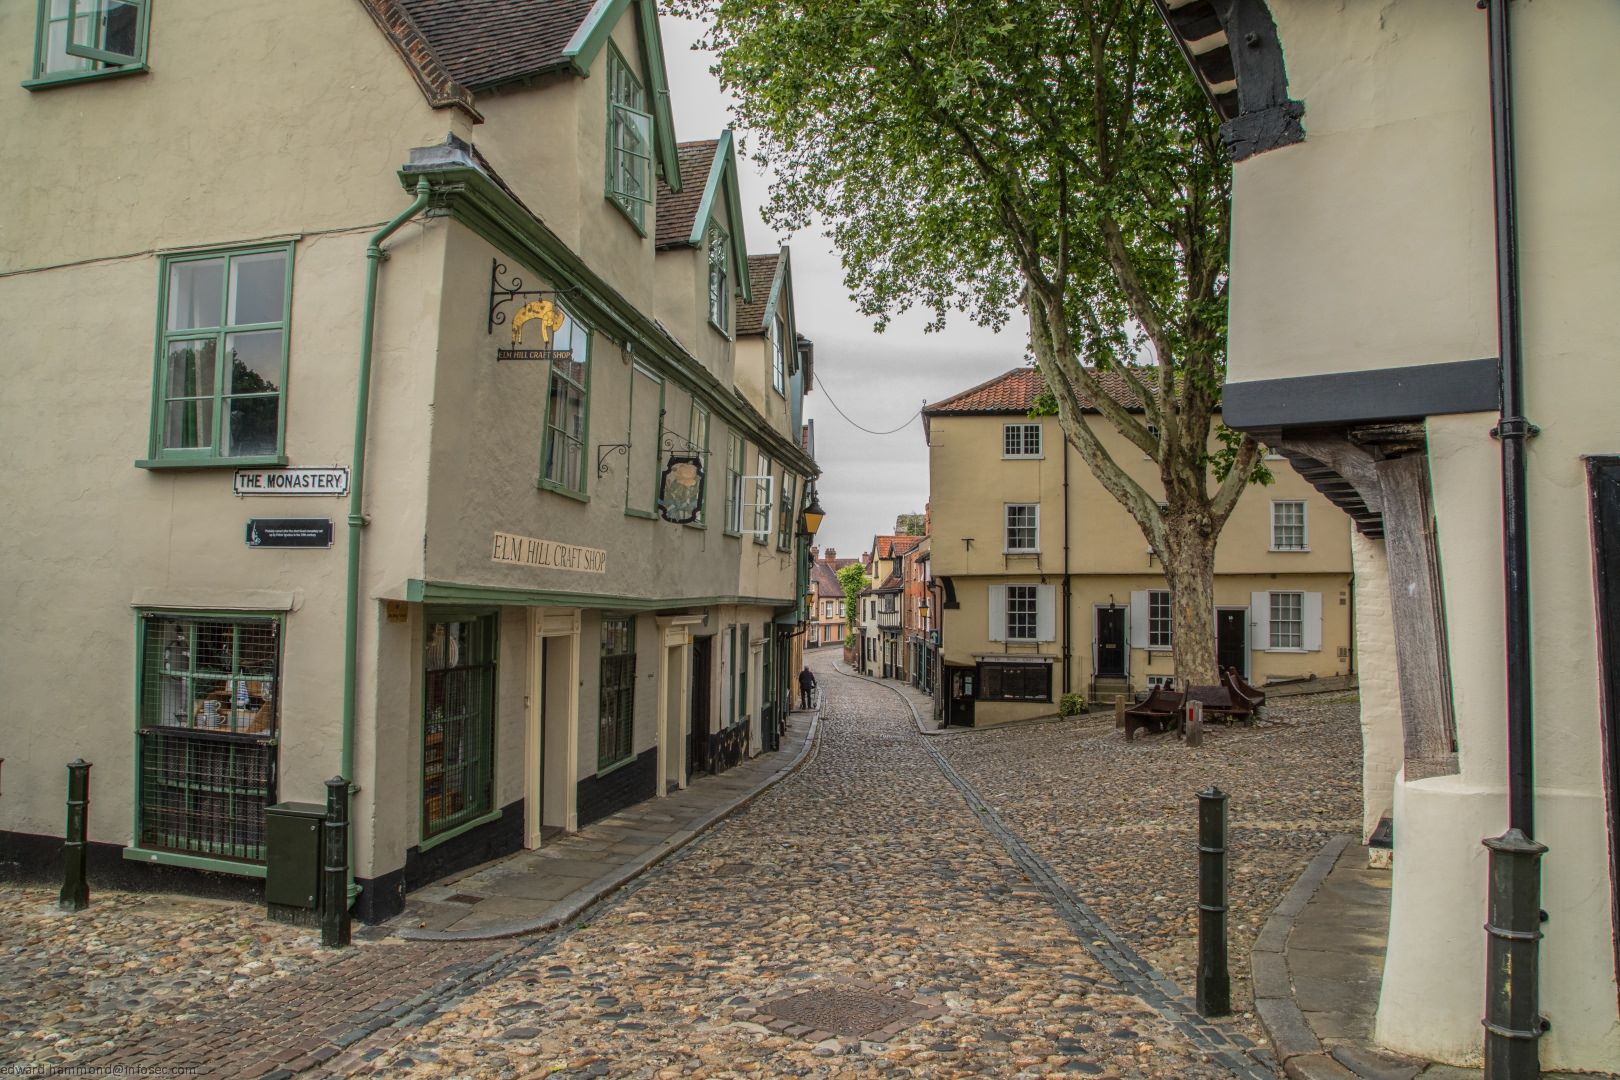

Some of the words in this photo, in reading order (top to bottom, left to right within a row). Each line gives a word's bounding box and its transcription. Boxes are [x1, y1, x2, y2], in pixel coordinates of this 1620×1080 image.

[499, 351, 512, 359] ELM
[513, 351, 528, 359] HILL
[529, 351, 551, 359] CRAFT
[553, 351, 571, 359] SHOP
[267, 474, 342, 489] MONASTERY
[493, 534, 523, 562] ELM
[527, 540, 551, 566] HILL
[553, 544, 583, 569] CRAFT
[584, 549, 606, 572] SHOP
